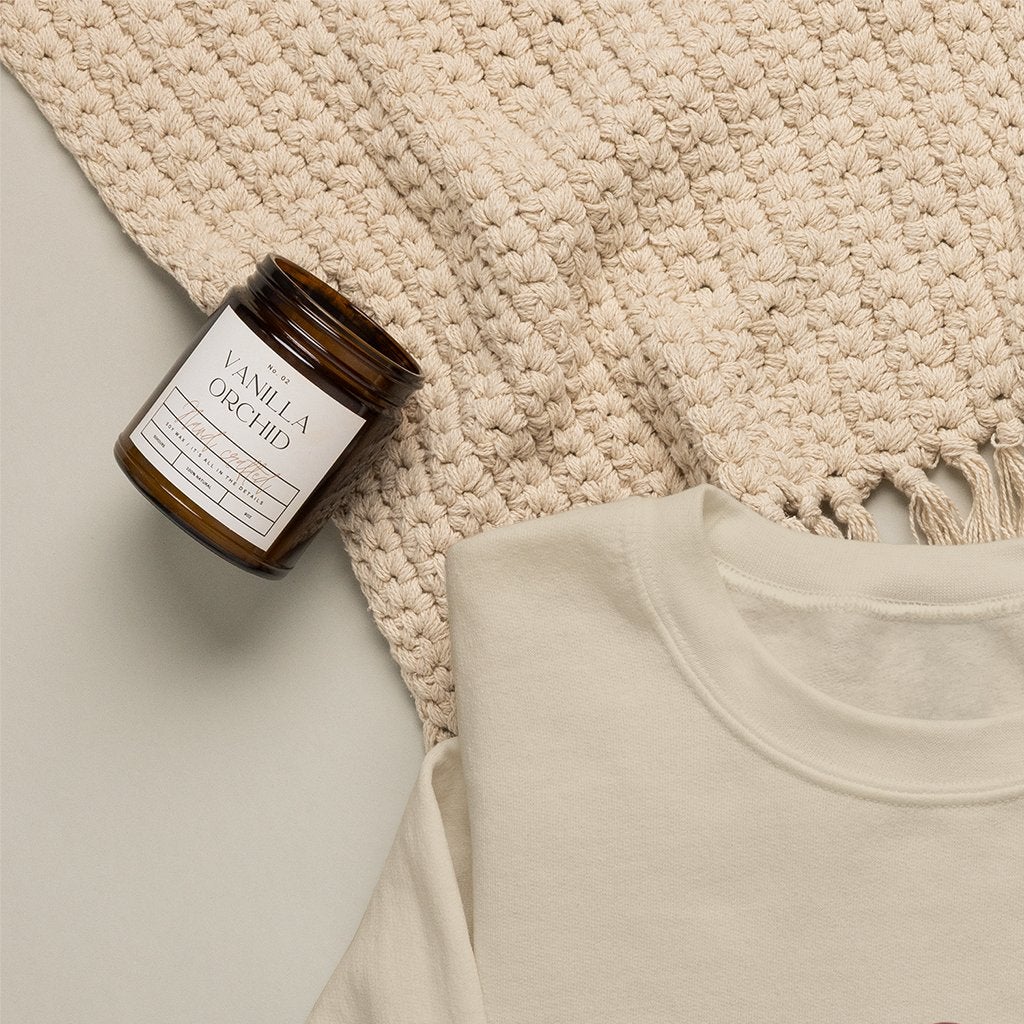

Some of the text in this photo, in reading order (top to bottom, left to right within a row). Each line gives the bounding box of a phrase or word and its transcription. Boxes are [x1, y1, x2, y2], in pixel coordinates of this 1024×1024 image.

[224, 349, 309, 434] VANILLA
[267, 364, 291, 385] No. 02
[208, 377, 290, 450] ORCHID
[203, 458, 214, 469] ALL
[215, 468, 224, 476] IN
[225, 475, 237, 486] THE
[238, 485, 264, 506] DETAILS
